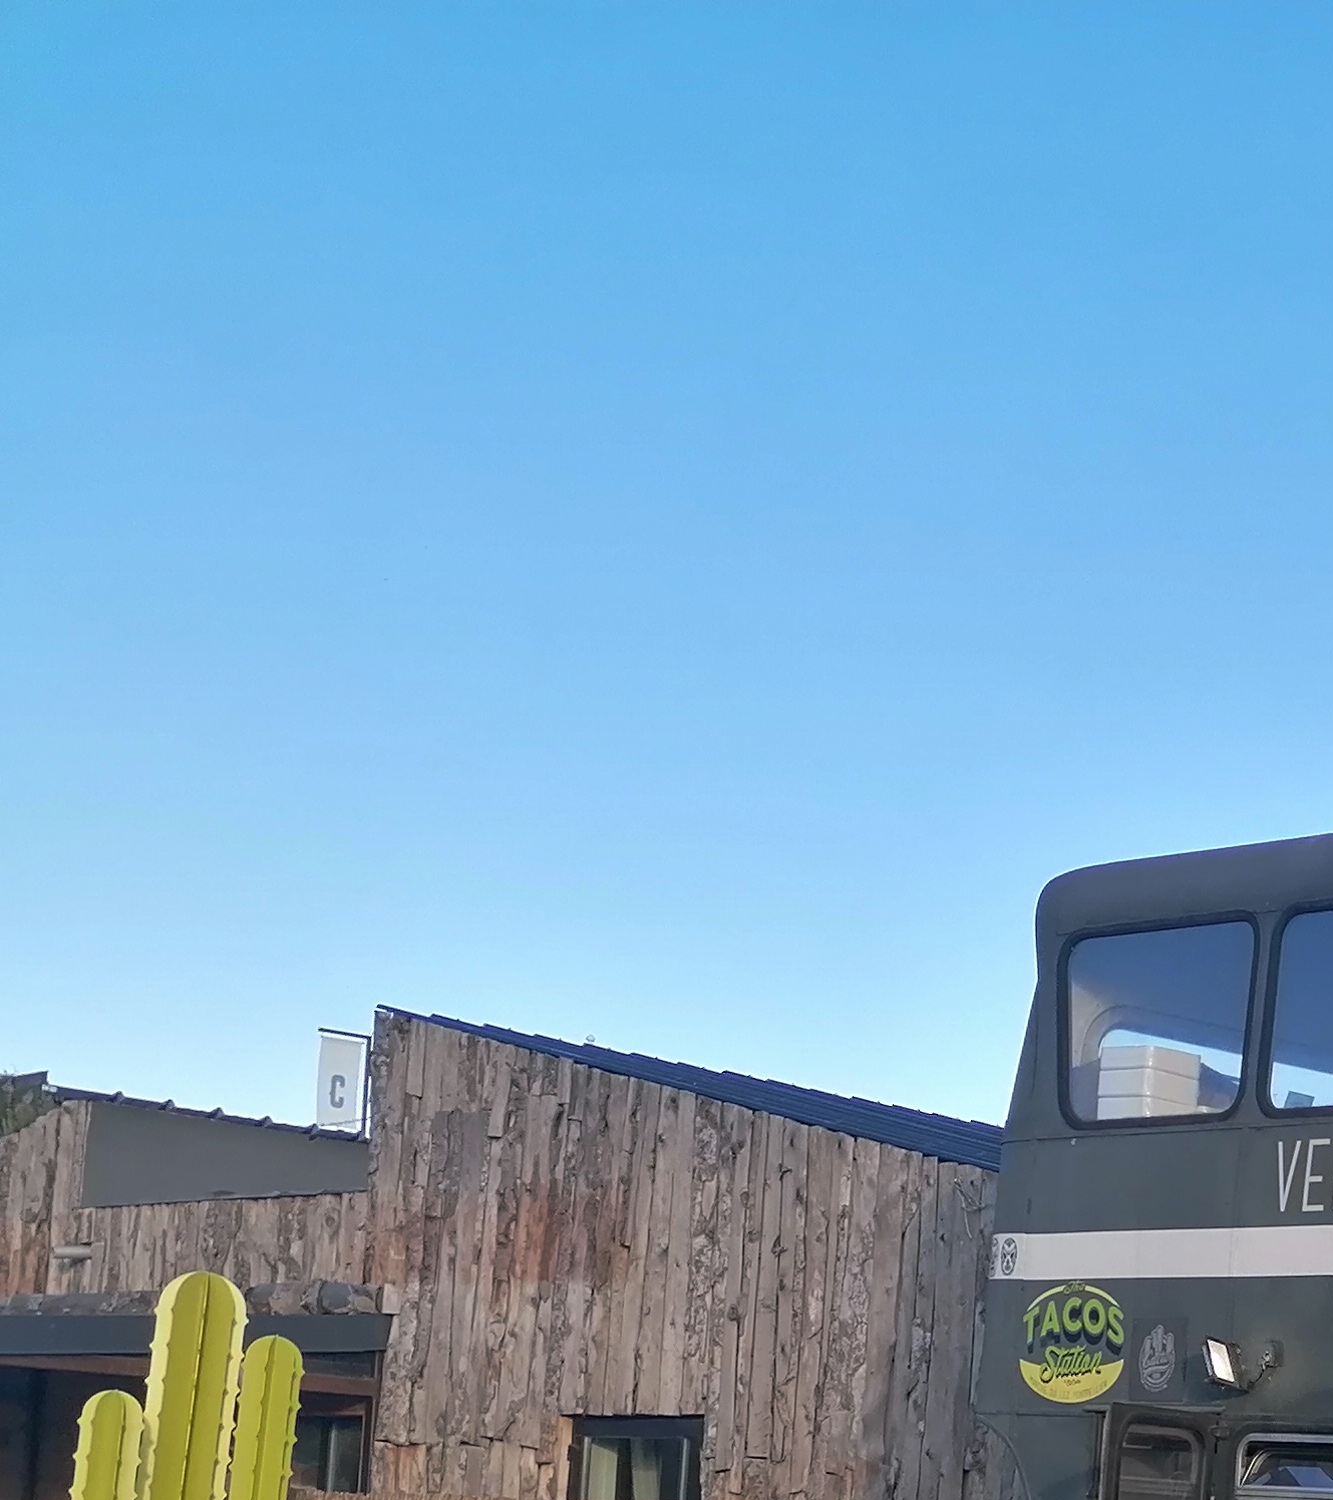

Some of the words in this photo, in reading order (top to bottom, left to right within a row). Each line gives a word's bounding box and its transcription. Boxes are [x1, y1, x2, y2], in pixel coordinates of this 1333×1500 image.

[330, 1074, 345, 1109] C
[1022, 1296, 1126, 1350] TACOS
[1040, 1345, 1103, 1383] Station
